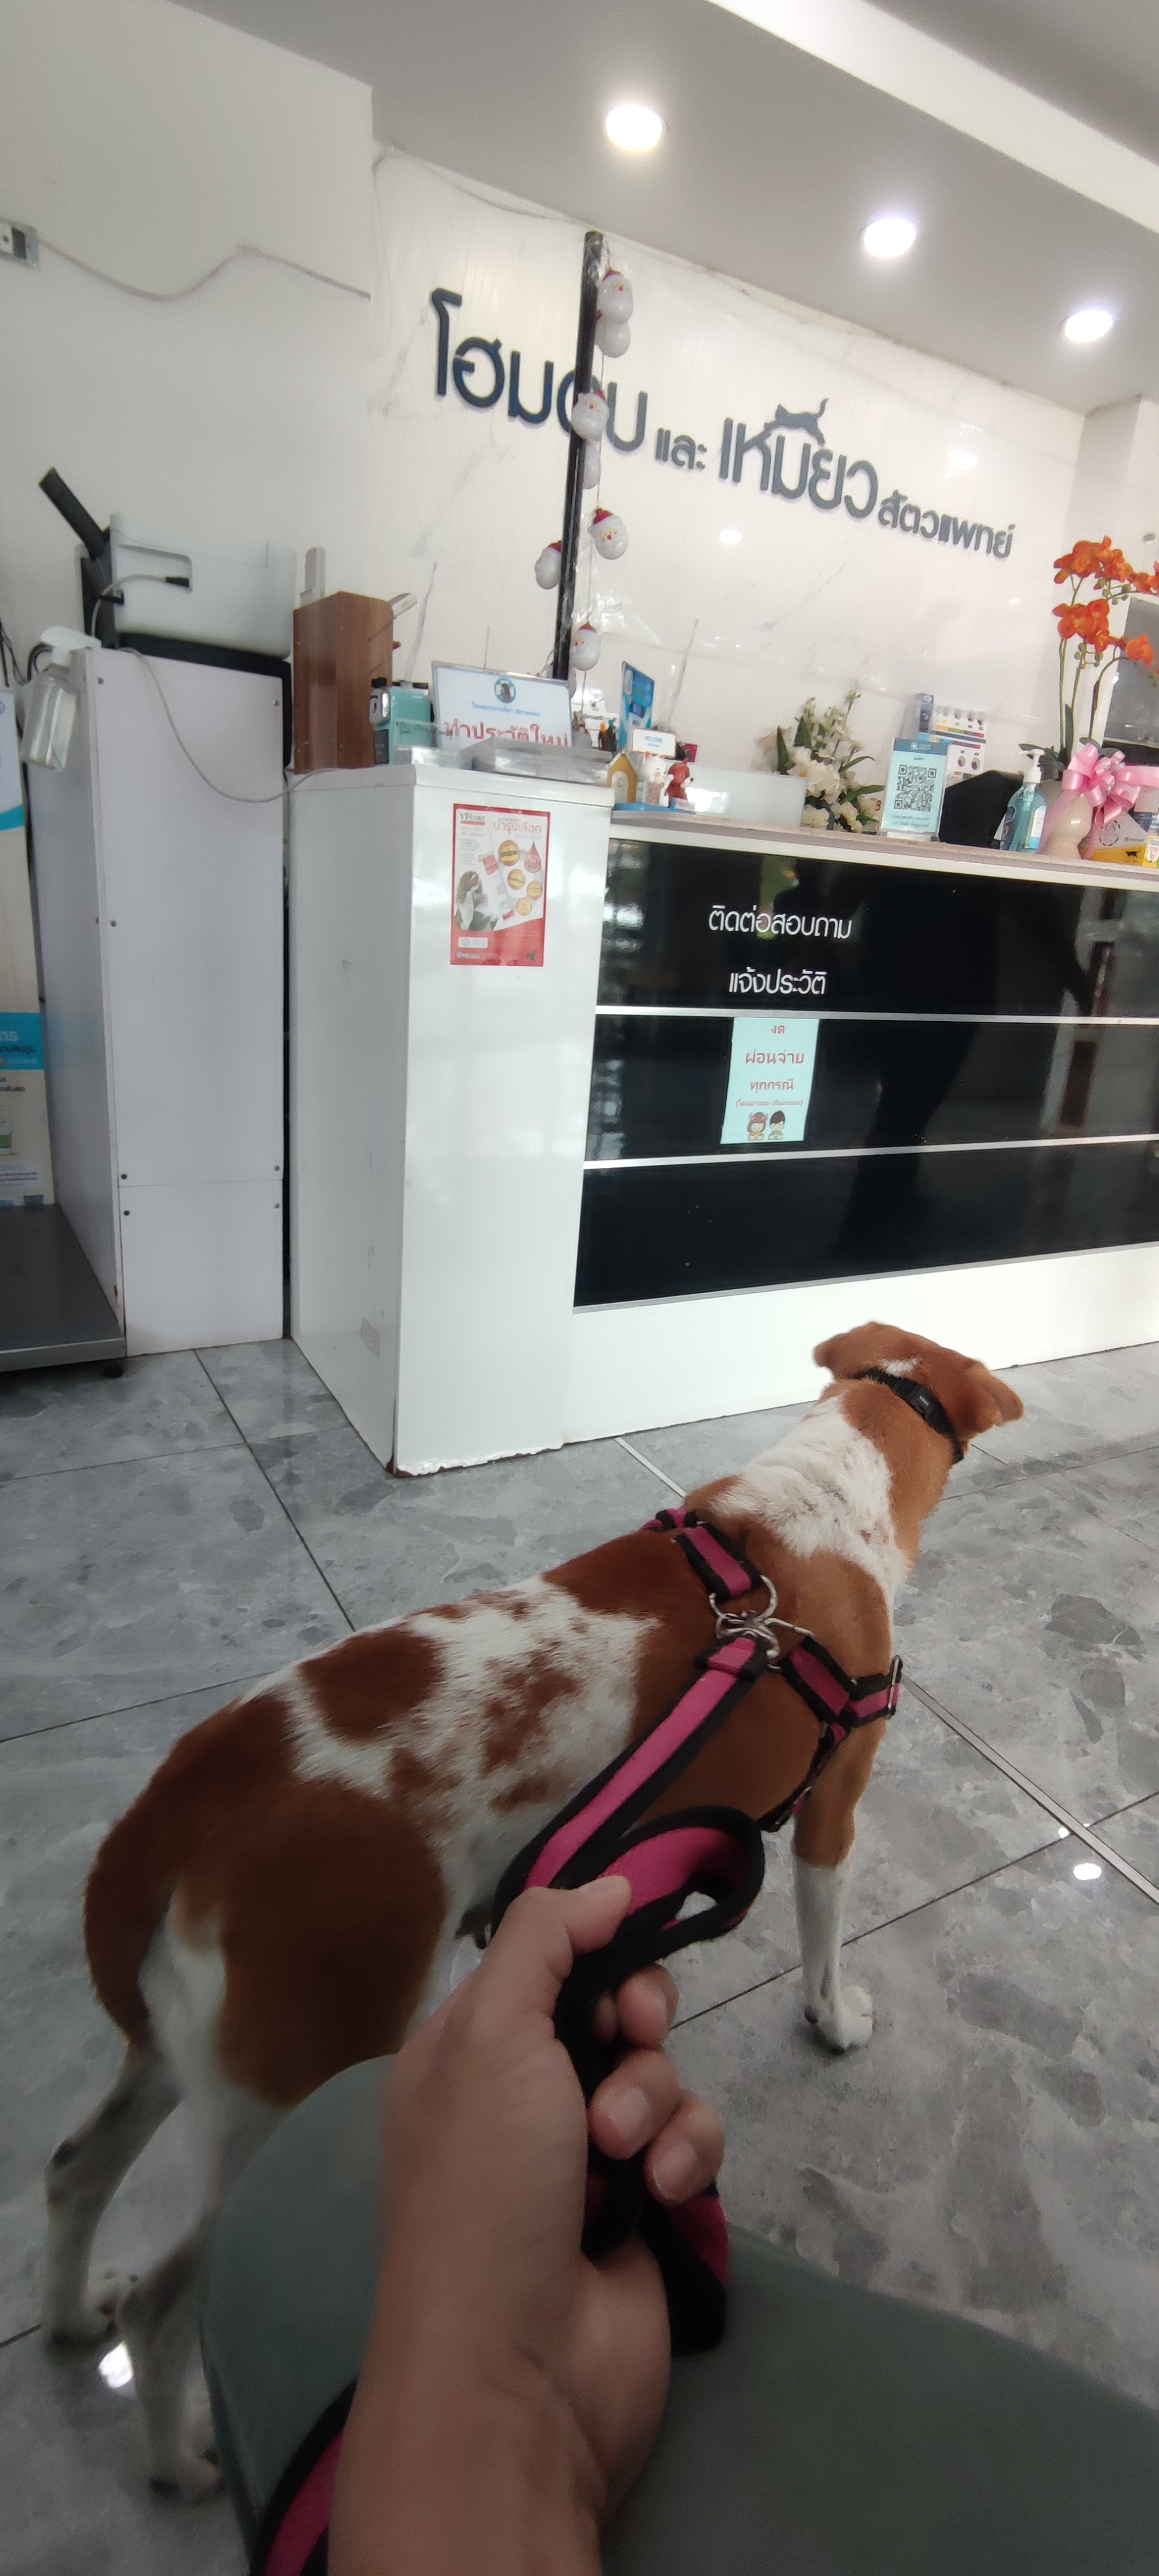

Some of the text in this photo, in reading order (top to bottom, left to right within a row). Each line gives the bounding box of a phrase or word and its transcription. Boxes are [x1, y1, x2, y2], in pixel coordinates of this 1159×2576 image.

[655, 427, 708, 471] และ
[878, 488, 1017, 559] สัตวแพทย์
[708, 905, 853, 939] ติดต่อสอบถาม
[729, 966, 828, 995] แจ้งประวัติ
[771, 1024, 786, 1035] งด
[745, 1048, 805, 1065] ผ่อนจ่าย
[749, 1077, 795, 1094] ทุกกรณี
